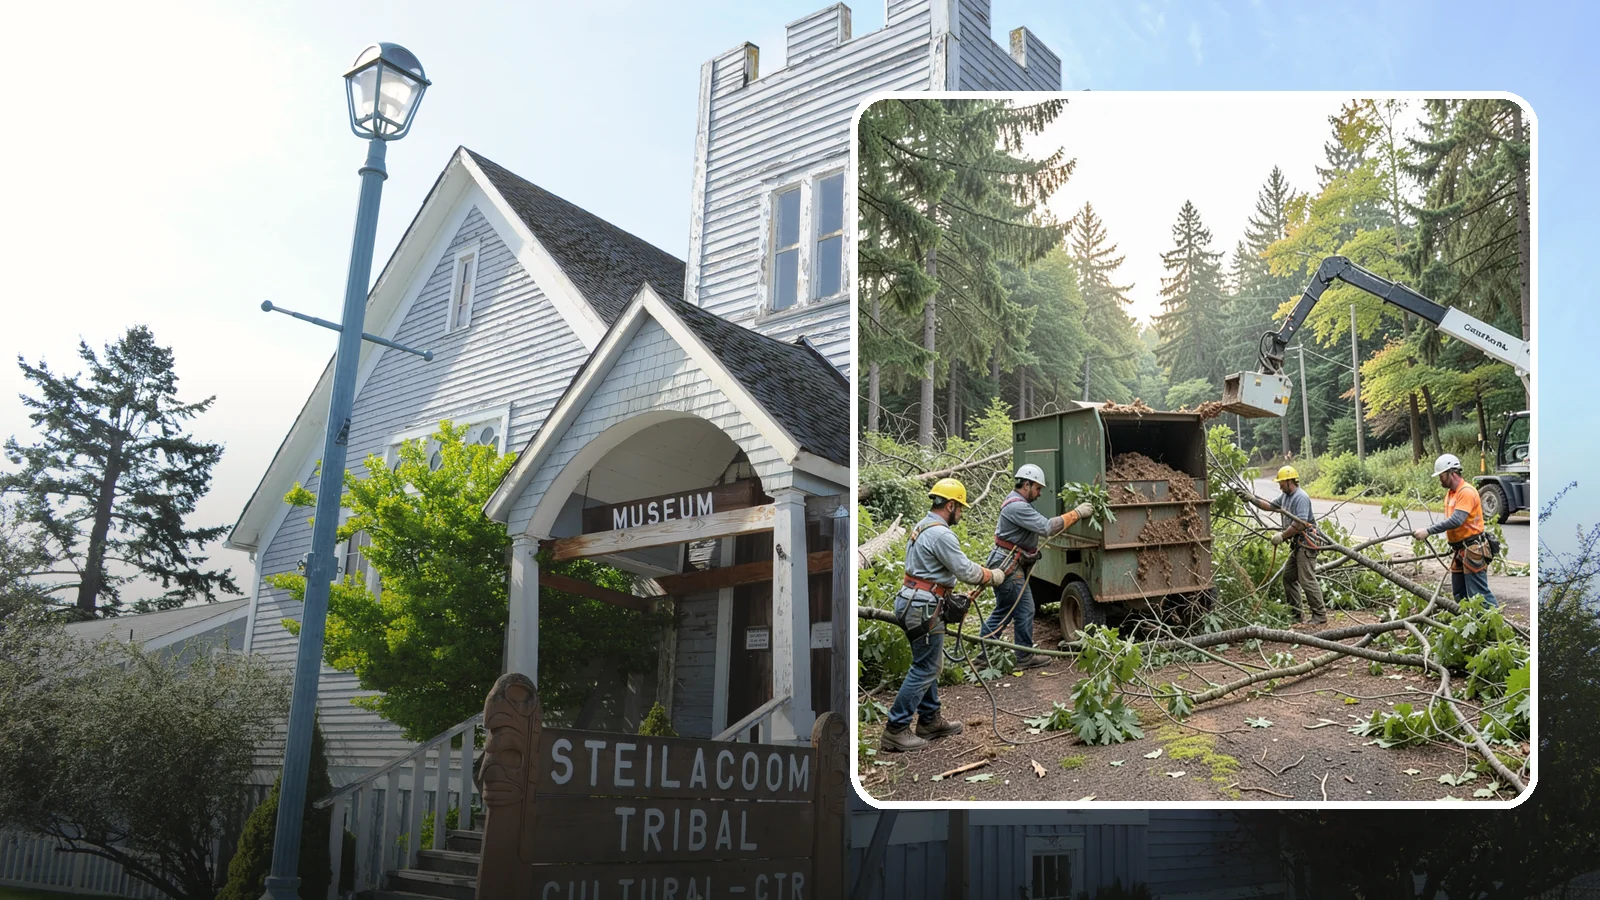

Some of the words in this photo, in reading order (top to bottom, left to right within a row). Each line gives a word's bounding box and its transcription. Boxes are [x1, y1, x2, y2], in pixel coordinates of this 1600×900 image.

[613, 491, 714, 531] MUSEUM
[550, 738, 810, 792] STEILACOOM
[614, 806, 758, 852] TRIBAL
